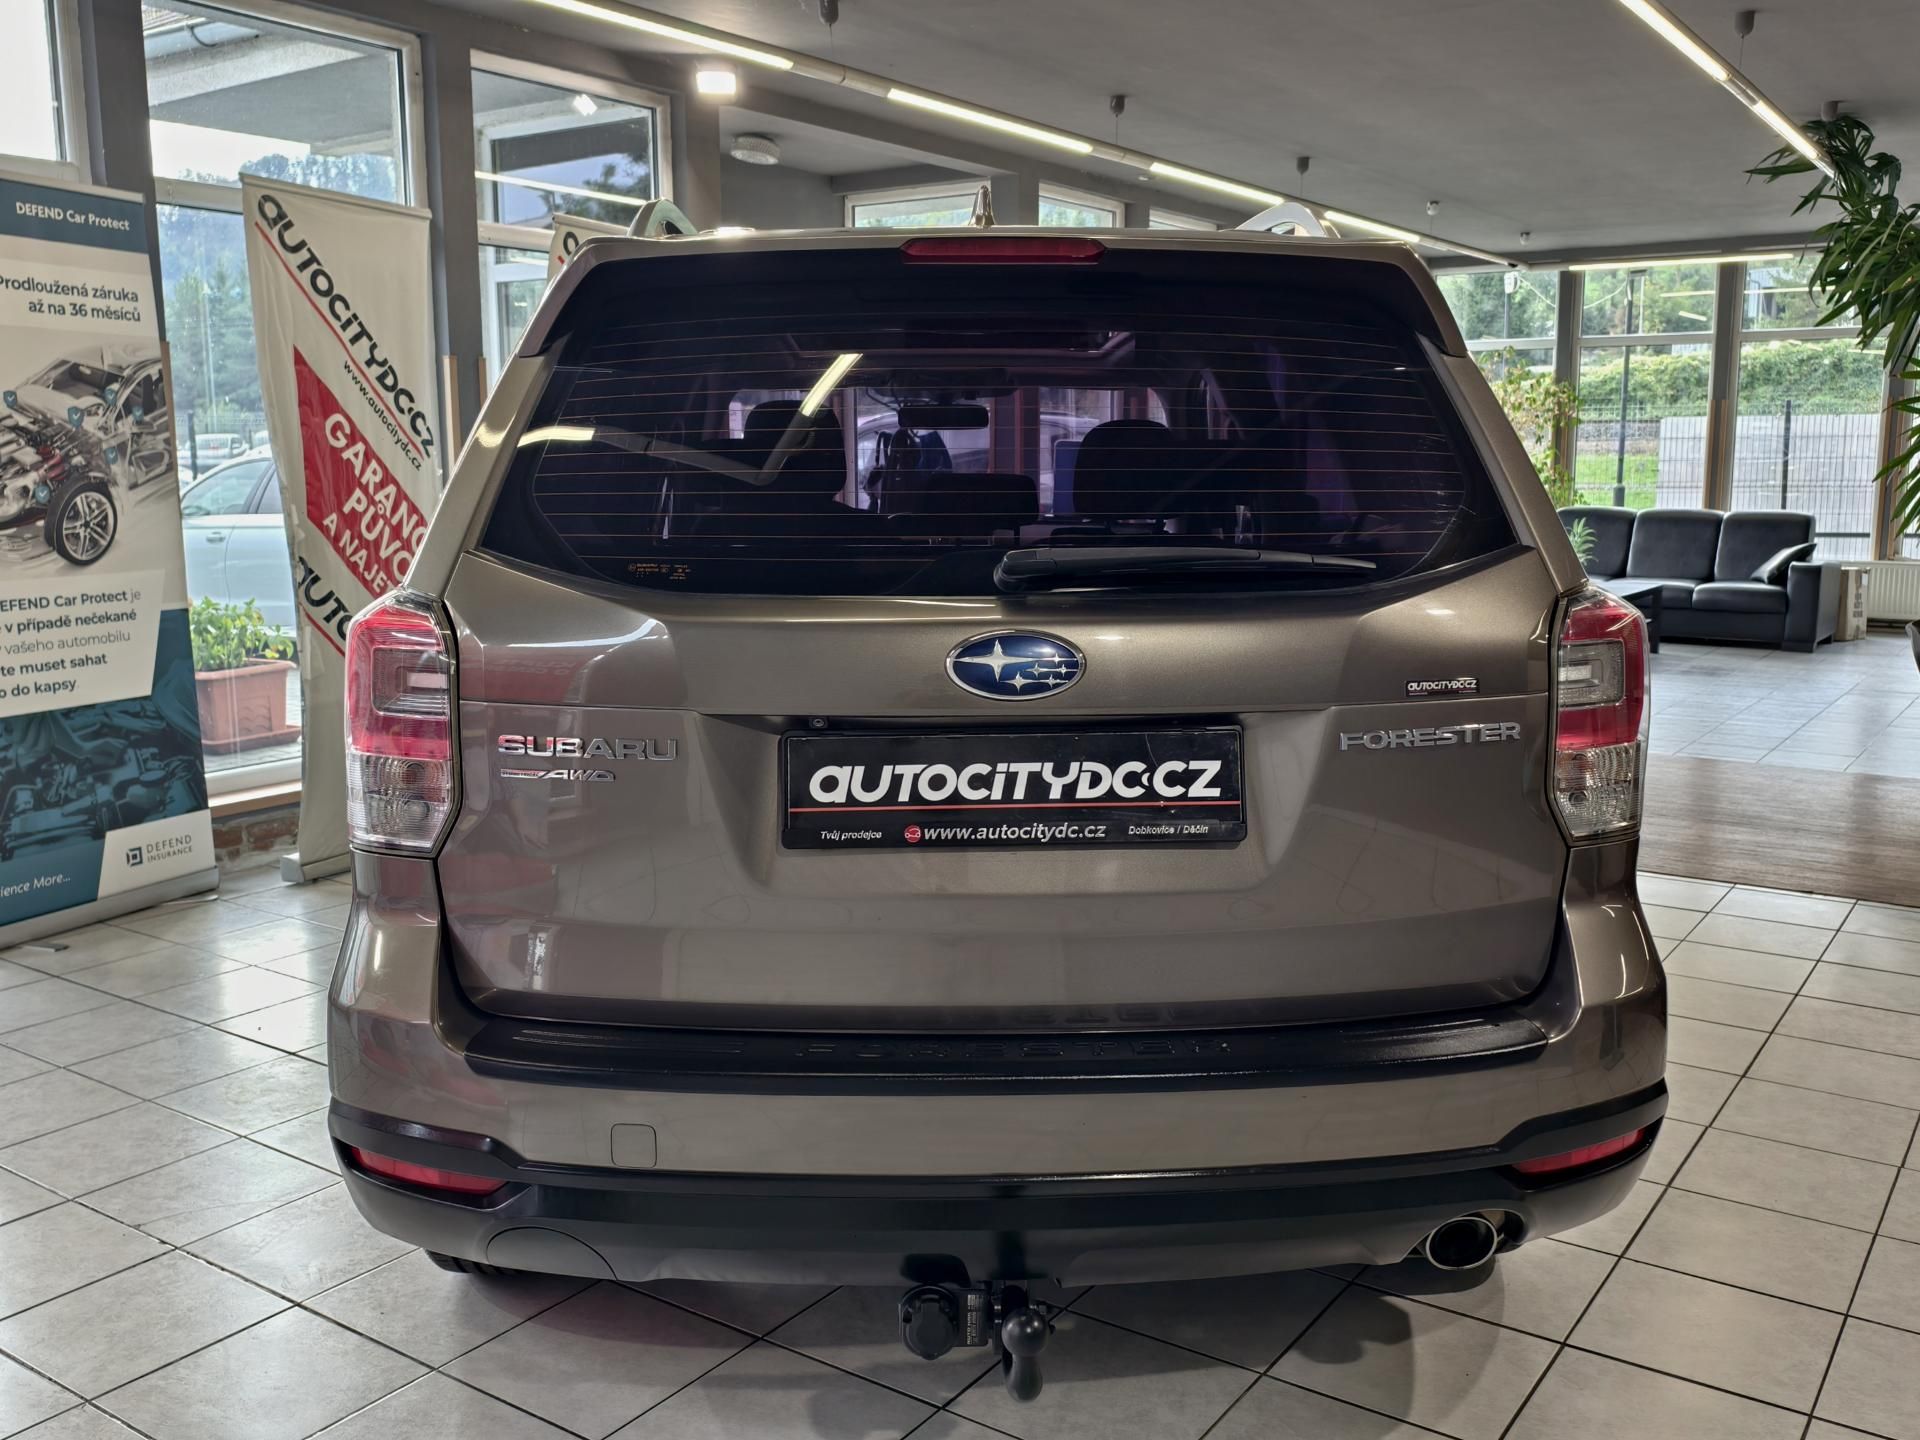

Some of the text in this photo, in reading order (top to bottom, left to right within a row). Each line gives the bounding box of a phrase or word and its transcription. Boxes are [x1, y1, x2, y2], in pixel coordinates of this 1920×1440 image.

[15, 201, 130, 231] DEFEND Car Protect
[92, 284, 139, 303] záruka
[28, 299, 141, 322] až na 36 měsíců
[343, 359, 424, 473] www.autocitydc.cz
[322, 512, 338, 537] A
[54, 595, 78, 608] Car
[81, 590, 128, 605] Protect
[130, 588, 142, 604] je
[4, 608, 137, 635] v případě nečekané
[4, 630, 131, 655] vašeho automobilu
[20, 658, 67, 675] muset
[70, 653, 108, 669] sahat
[11, 684, 31, 697] do
[498, 734, 677, 761] SUBARU
[1339, 722, 1521, 750] FORESTER
[820, 829, 841, 841] Tvůj
[841, 829, 883, 841] prodejce
[923, 820, 1107, 842] www.autocitydc.cz
[1127, 825, 1175, 835] Dobkovice
[146, 834, 192, 853] DEFEND
[147, 845, 193, 862] INSURANCE
